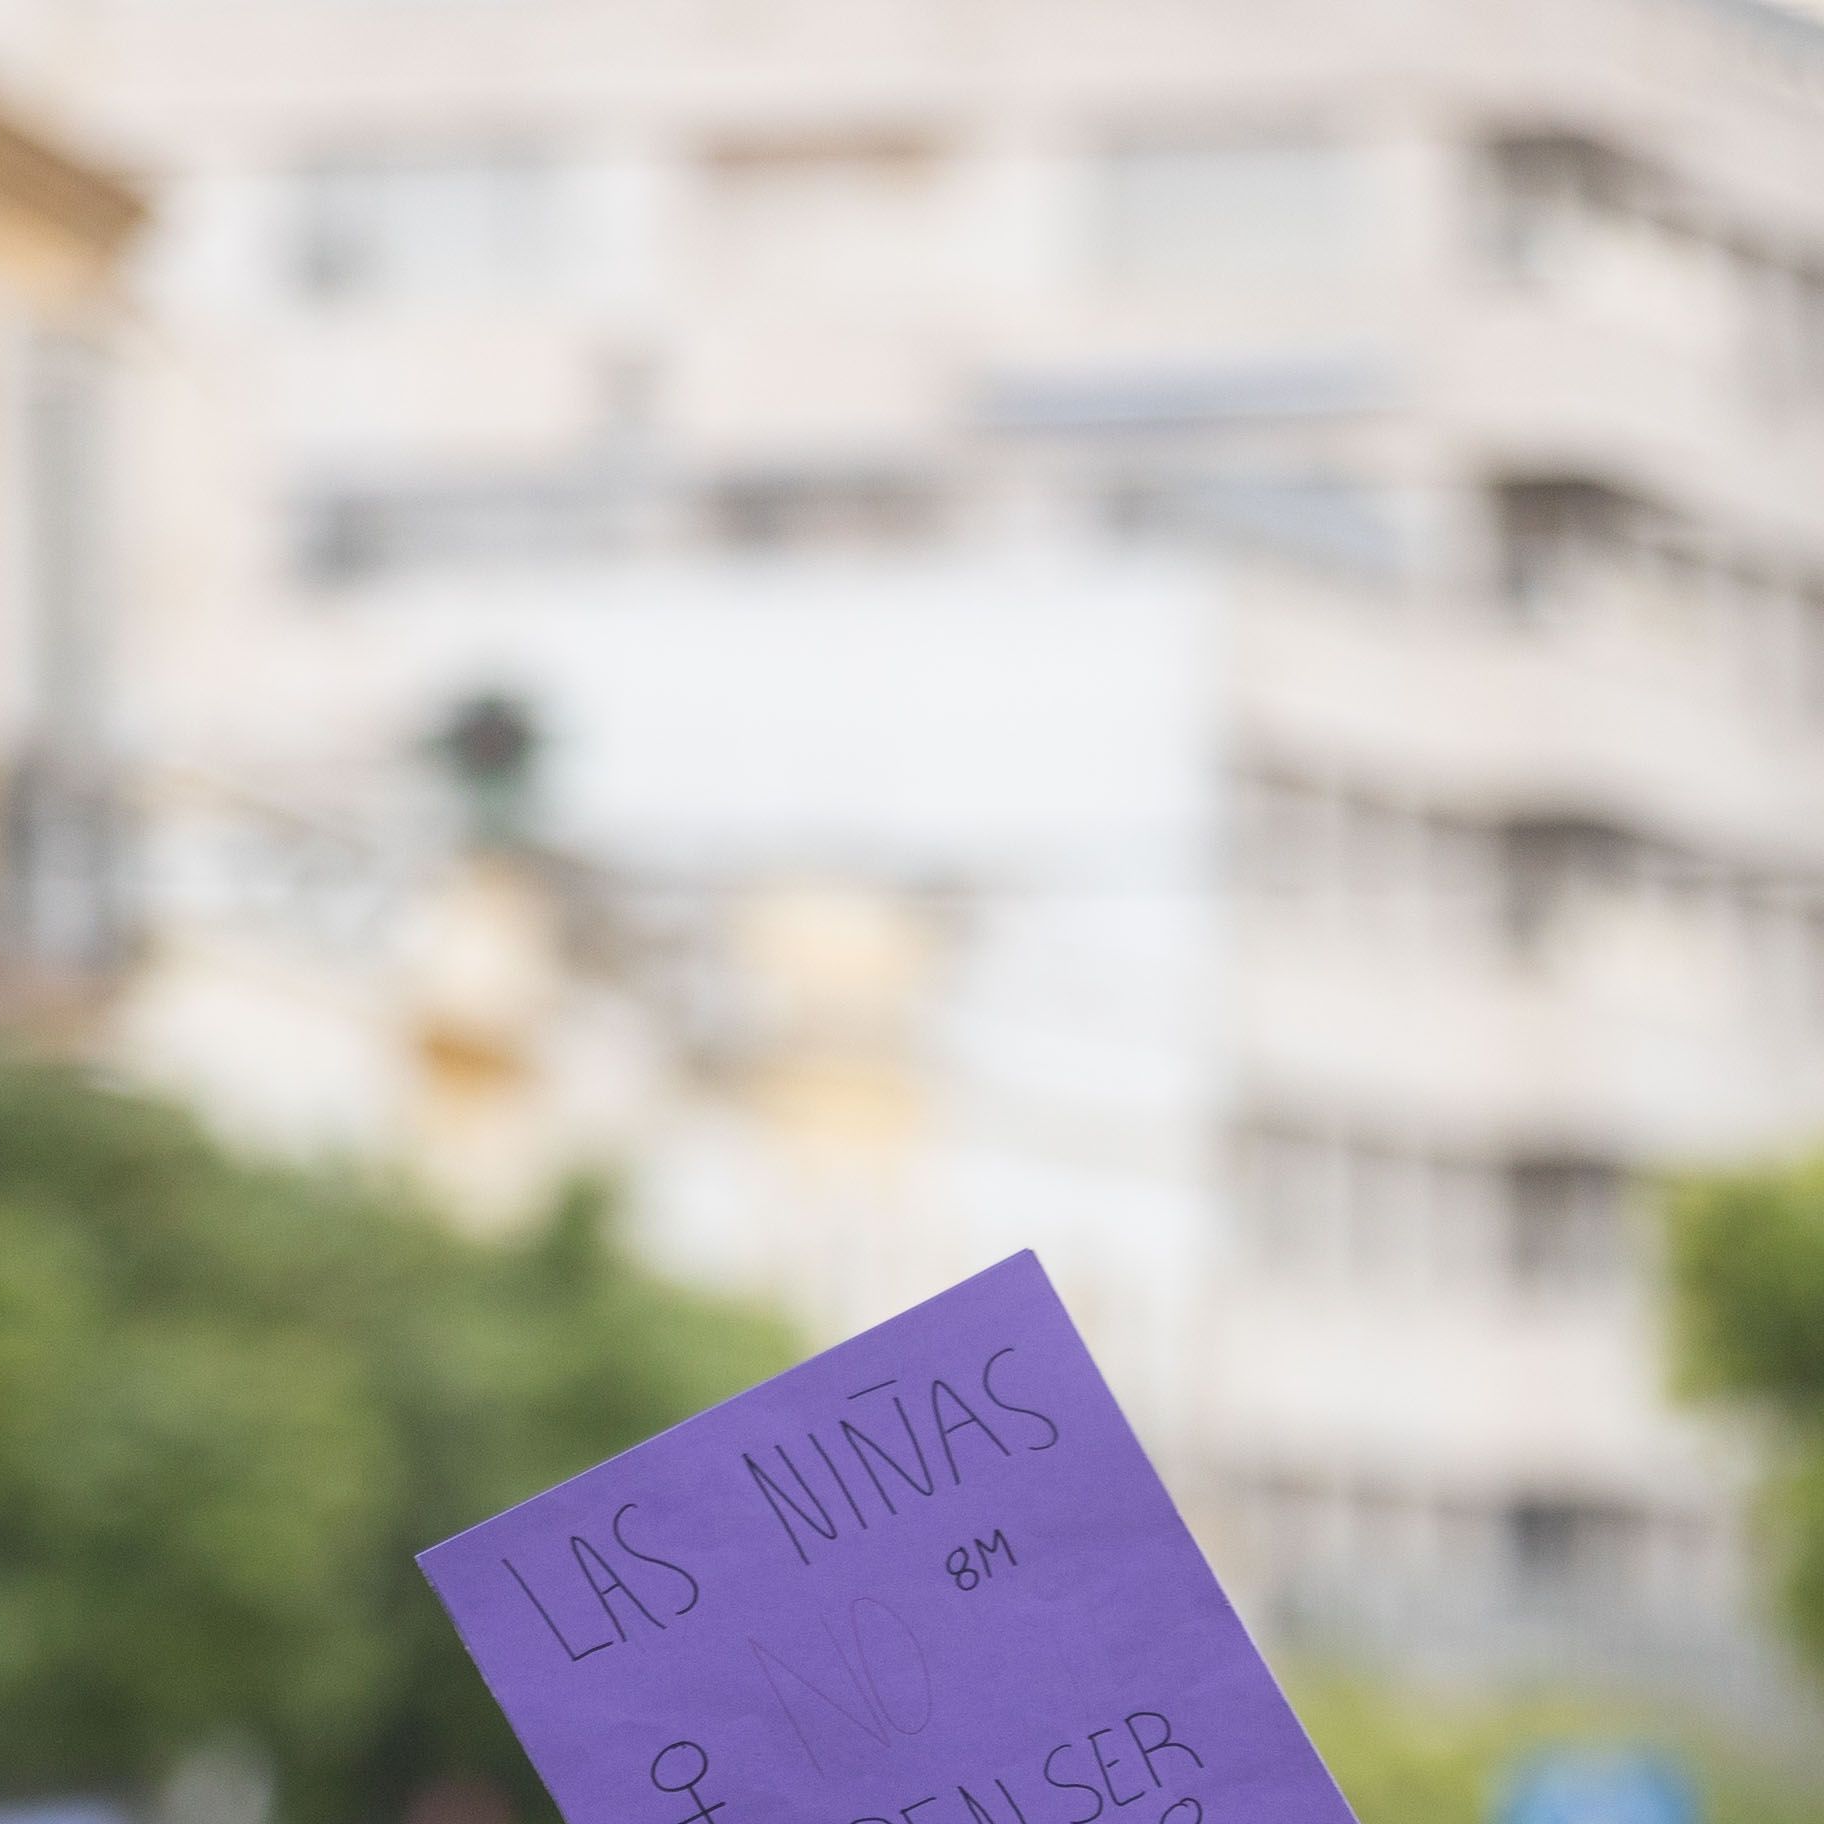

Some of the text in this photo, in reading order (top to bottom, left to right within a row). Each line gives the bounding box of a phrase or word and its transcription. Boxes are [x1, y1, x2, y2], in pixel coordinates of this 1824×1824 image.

[501, 1347, 1059, 1662] LAS NIÑAS
[945, 1528, 1018, 1592] 8M
[745, 1595, 934, 1775] NO
